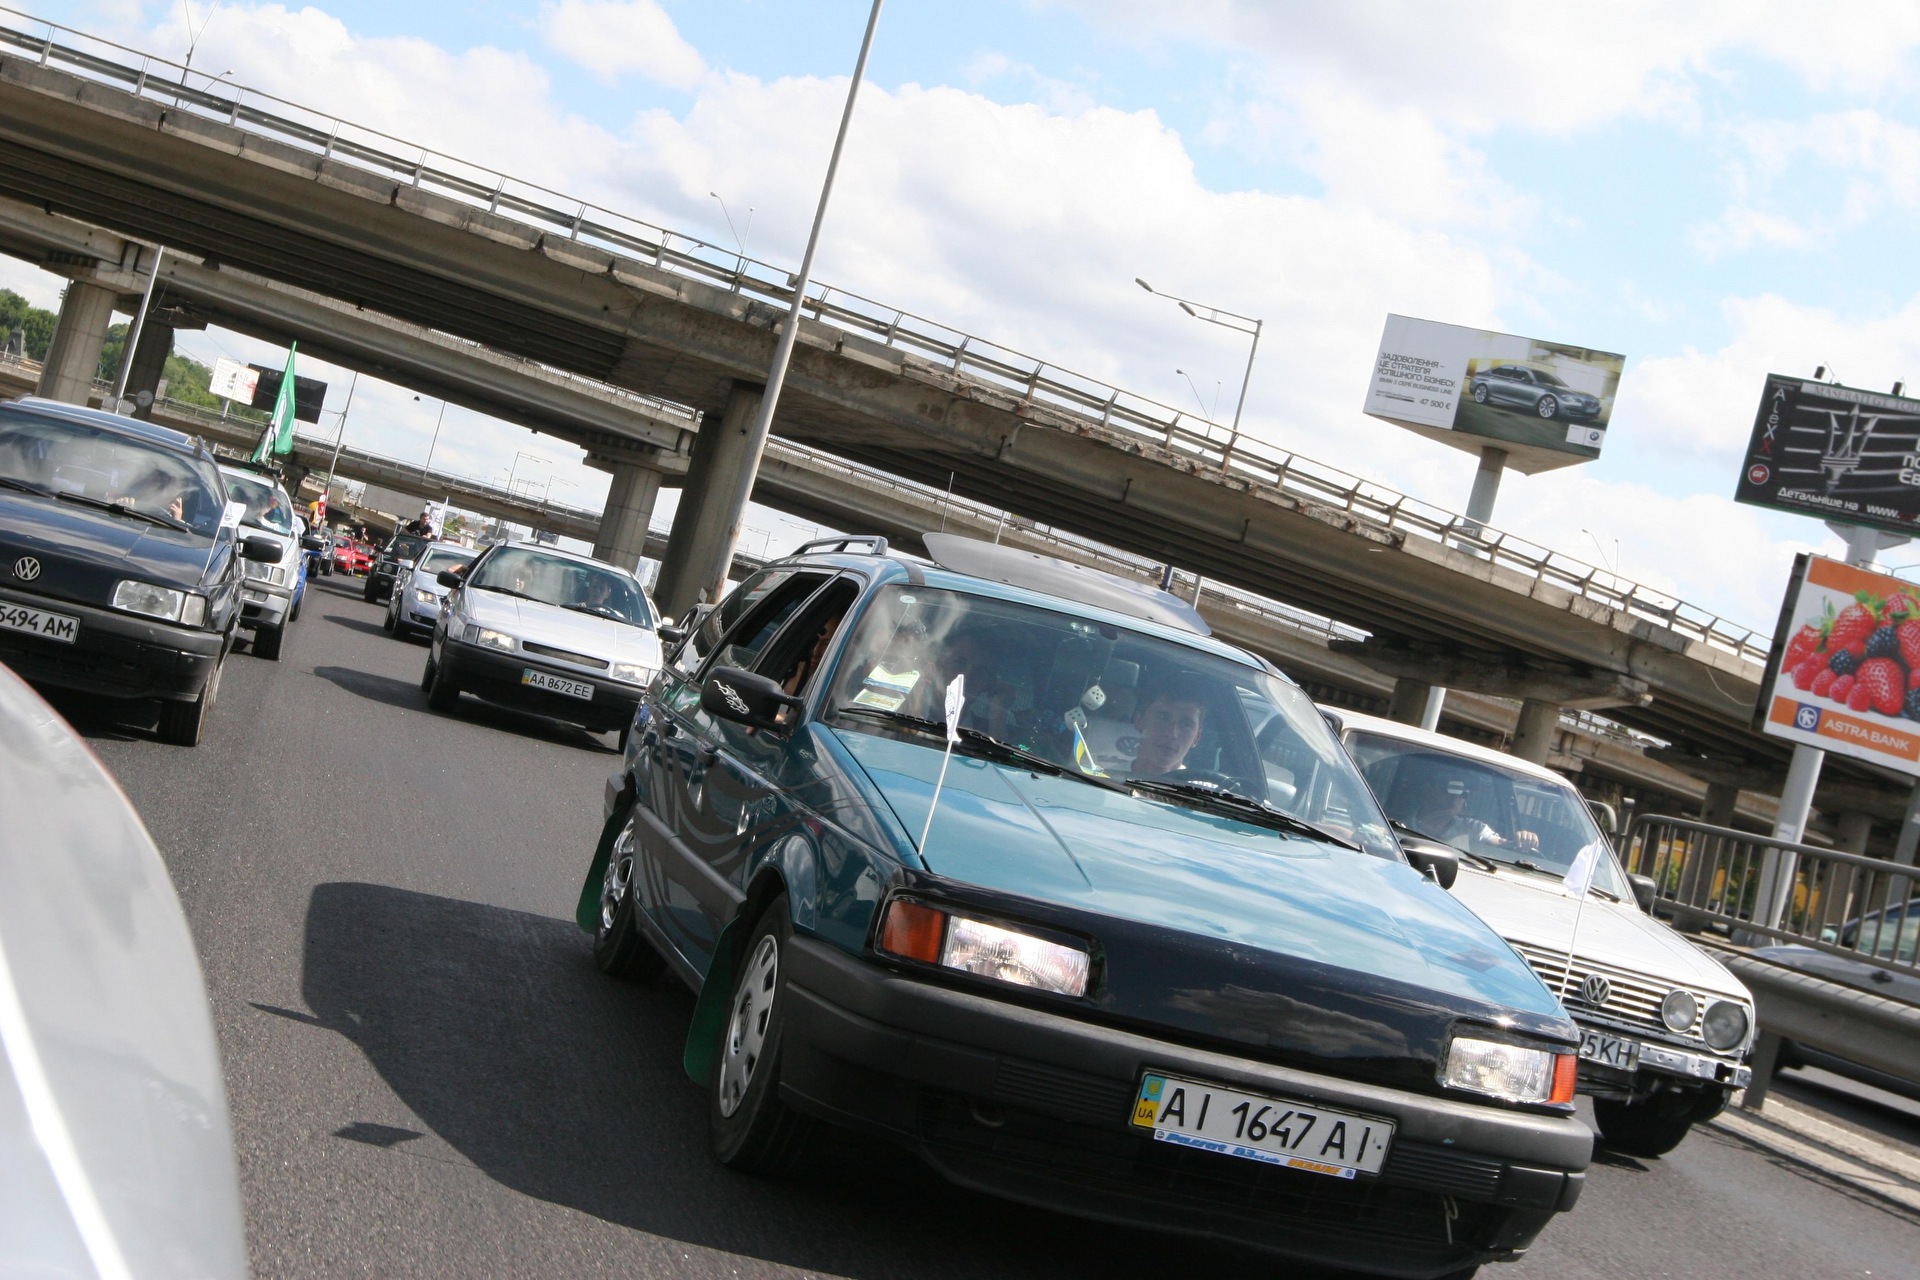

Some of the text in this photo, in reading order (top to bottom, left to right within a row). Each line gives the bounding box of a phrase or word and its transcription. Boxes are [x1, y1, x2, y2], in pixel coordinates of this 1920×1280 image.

[1381, 353, 1439, 368] ЗАДОВОЛЕННЯ
[1391, 362, 1431, 374] СТРАТЕГІЯ
[1377, 368, 1422, 381] УСПІШНОГО
[1413, 383, 1439, 392] BUSINESS
[1430, 400, 1444, 408] 500
[1777, 487, 1843, 508] Детальніше
[1844, 501, 1859, 511] на
[42, 617, 74, 638] AM
[530, 673, 590, 697] AA 8672 EE
[1824, 718, 1910, 751] ASTRA BANK
[1137, 1106, 1154, 1121] UA
[1158, 1087, 1371, 1163] AI 1647 AI
[1286, 1158, 1342, 1175] UKRAINE
